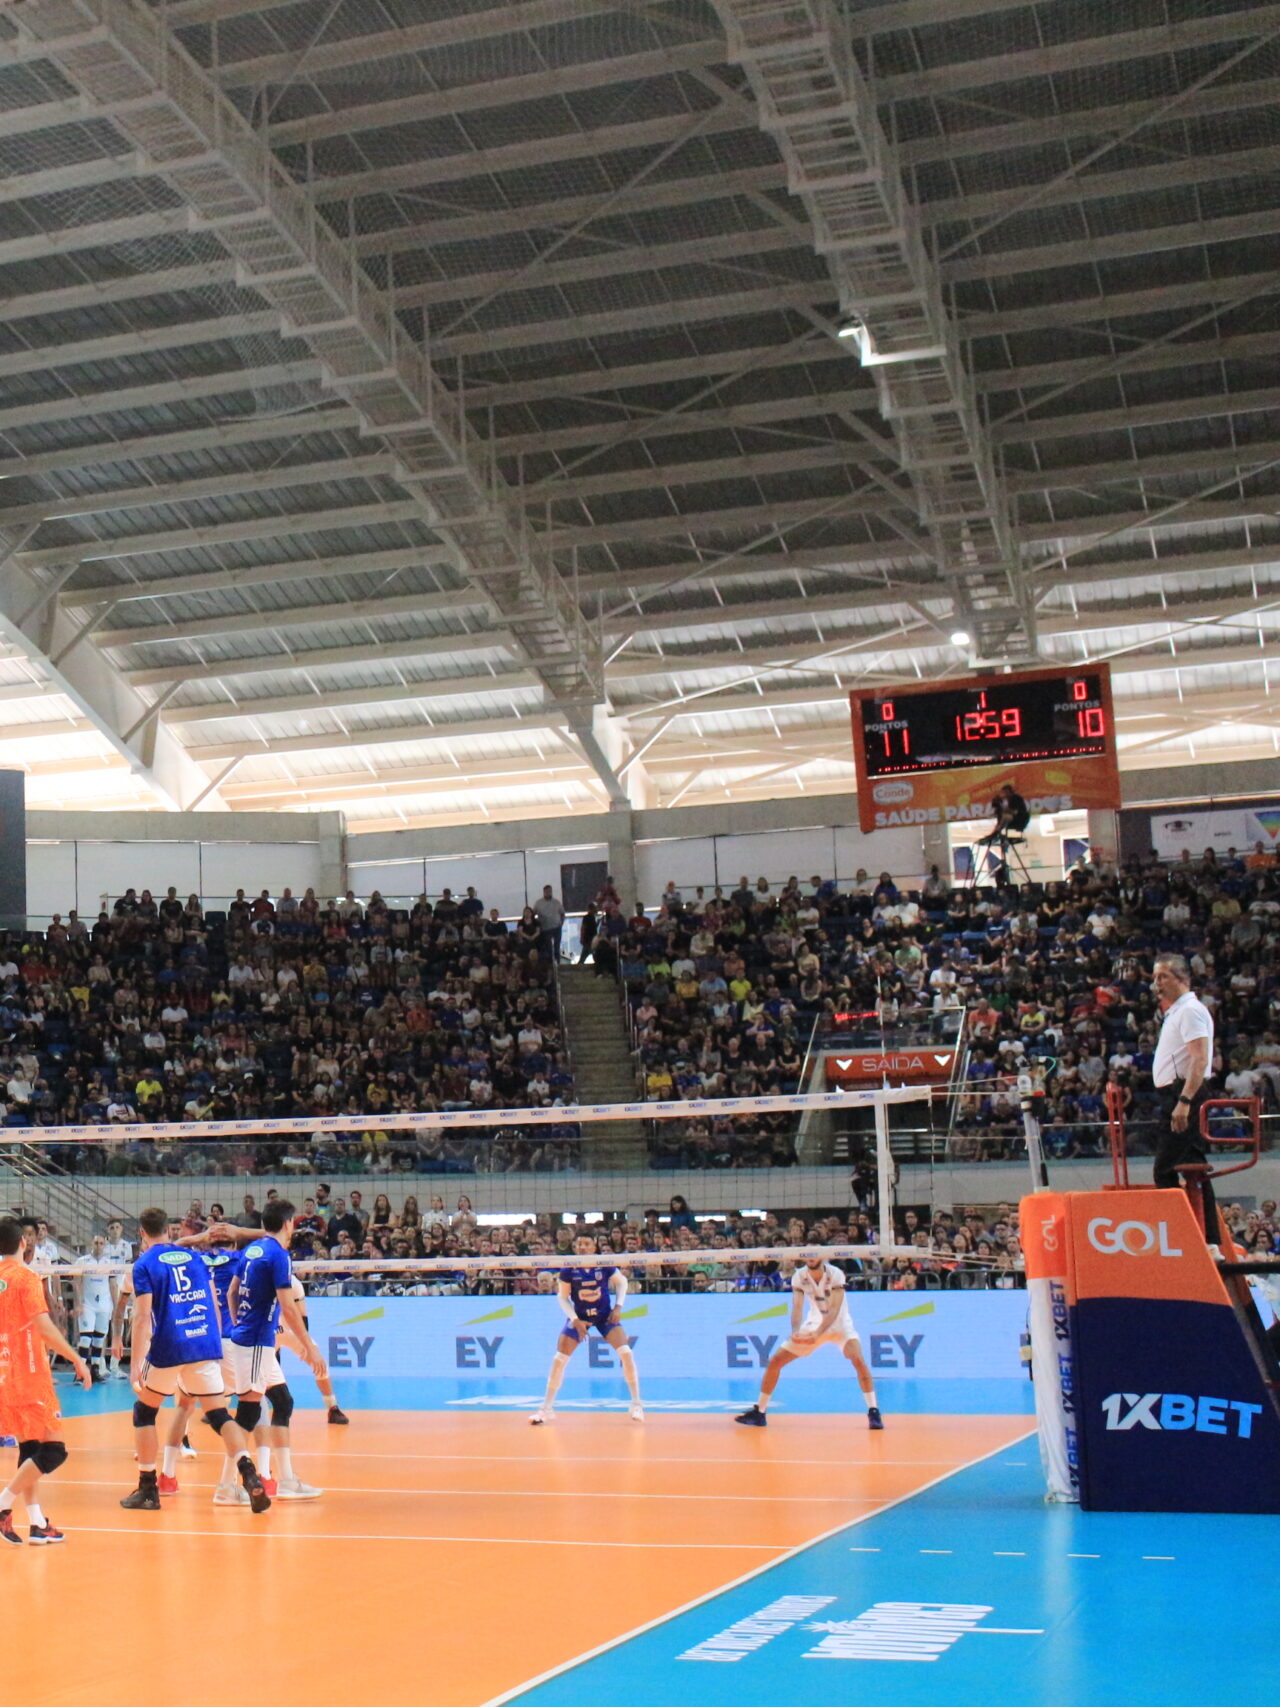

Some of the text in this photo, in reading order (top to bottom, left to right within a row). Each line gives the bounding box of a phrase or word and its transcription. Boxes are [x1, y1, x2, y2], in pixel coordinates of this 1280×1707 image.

[1054, 699, 1101, 713] PONTOS
[1073, 681, 1088, 701] 0
[864, 719, 909, 733] PONTOS
[882, 702, 895, 721] 0
[955, 708, 1022, 742] 12:59
[1078, 708, 1106, 738] 10
[883, 728, 910, 758] 11
[875, 807, 941, 827] SAÚDE
[1041, 1215, 1058, 1251] GOL
[1087, 1217, 1183, 1257] GOL
[172, 1265, 192, 1292] 15
[169, 1288, 207, 1304] VACCARI
[1050, 1280, 1071, 1341] 1XBET
[328, 1336, 376, 1368] EY
[456, 1336, 504, 1368] EY
[726, 1335, 779, 1368] EY
[870, 1334, 925, 1368] EY
[1101, 1392, 1263, 1439] 1XBET
